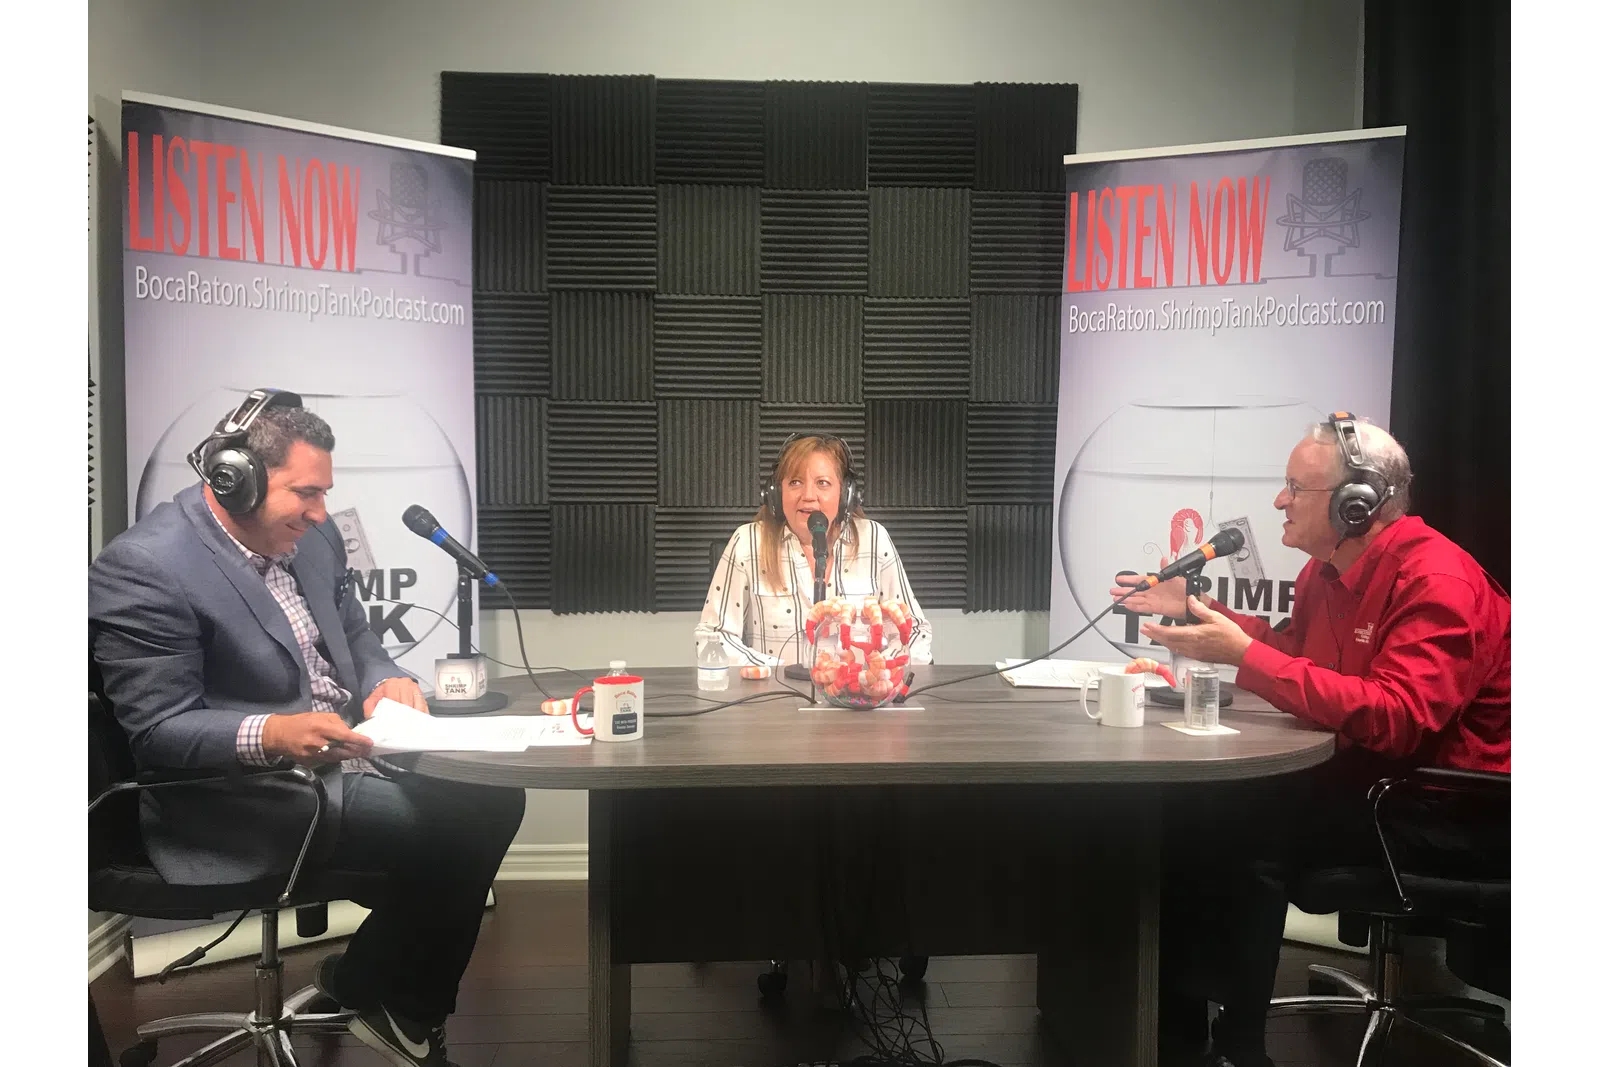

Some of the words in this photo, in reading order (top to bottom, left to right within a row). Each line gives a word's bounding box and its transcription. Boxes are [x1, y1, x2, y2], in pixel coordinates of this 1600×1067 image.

[128, 131, 265, 264] LISTEN
[278, 154, 361, 273] NOW
[1067, 183, 1177, 292] LISTEN
[1187, 176, 1271, 286] NOW
[135, 265, 465, 326] BocaRaton.ShrimpTankPodcast.com
[1068, 294, 1385, 335] BocaRaton.ShrimpTankPodcast.com
